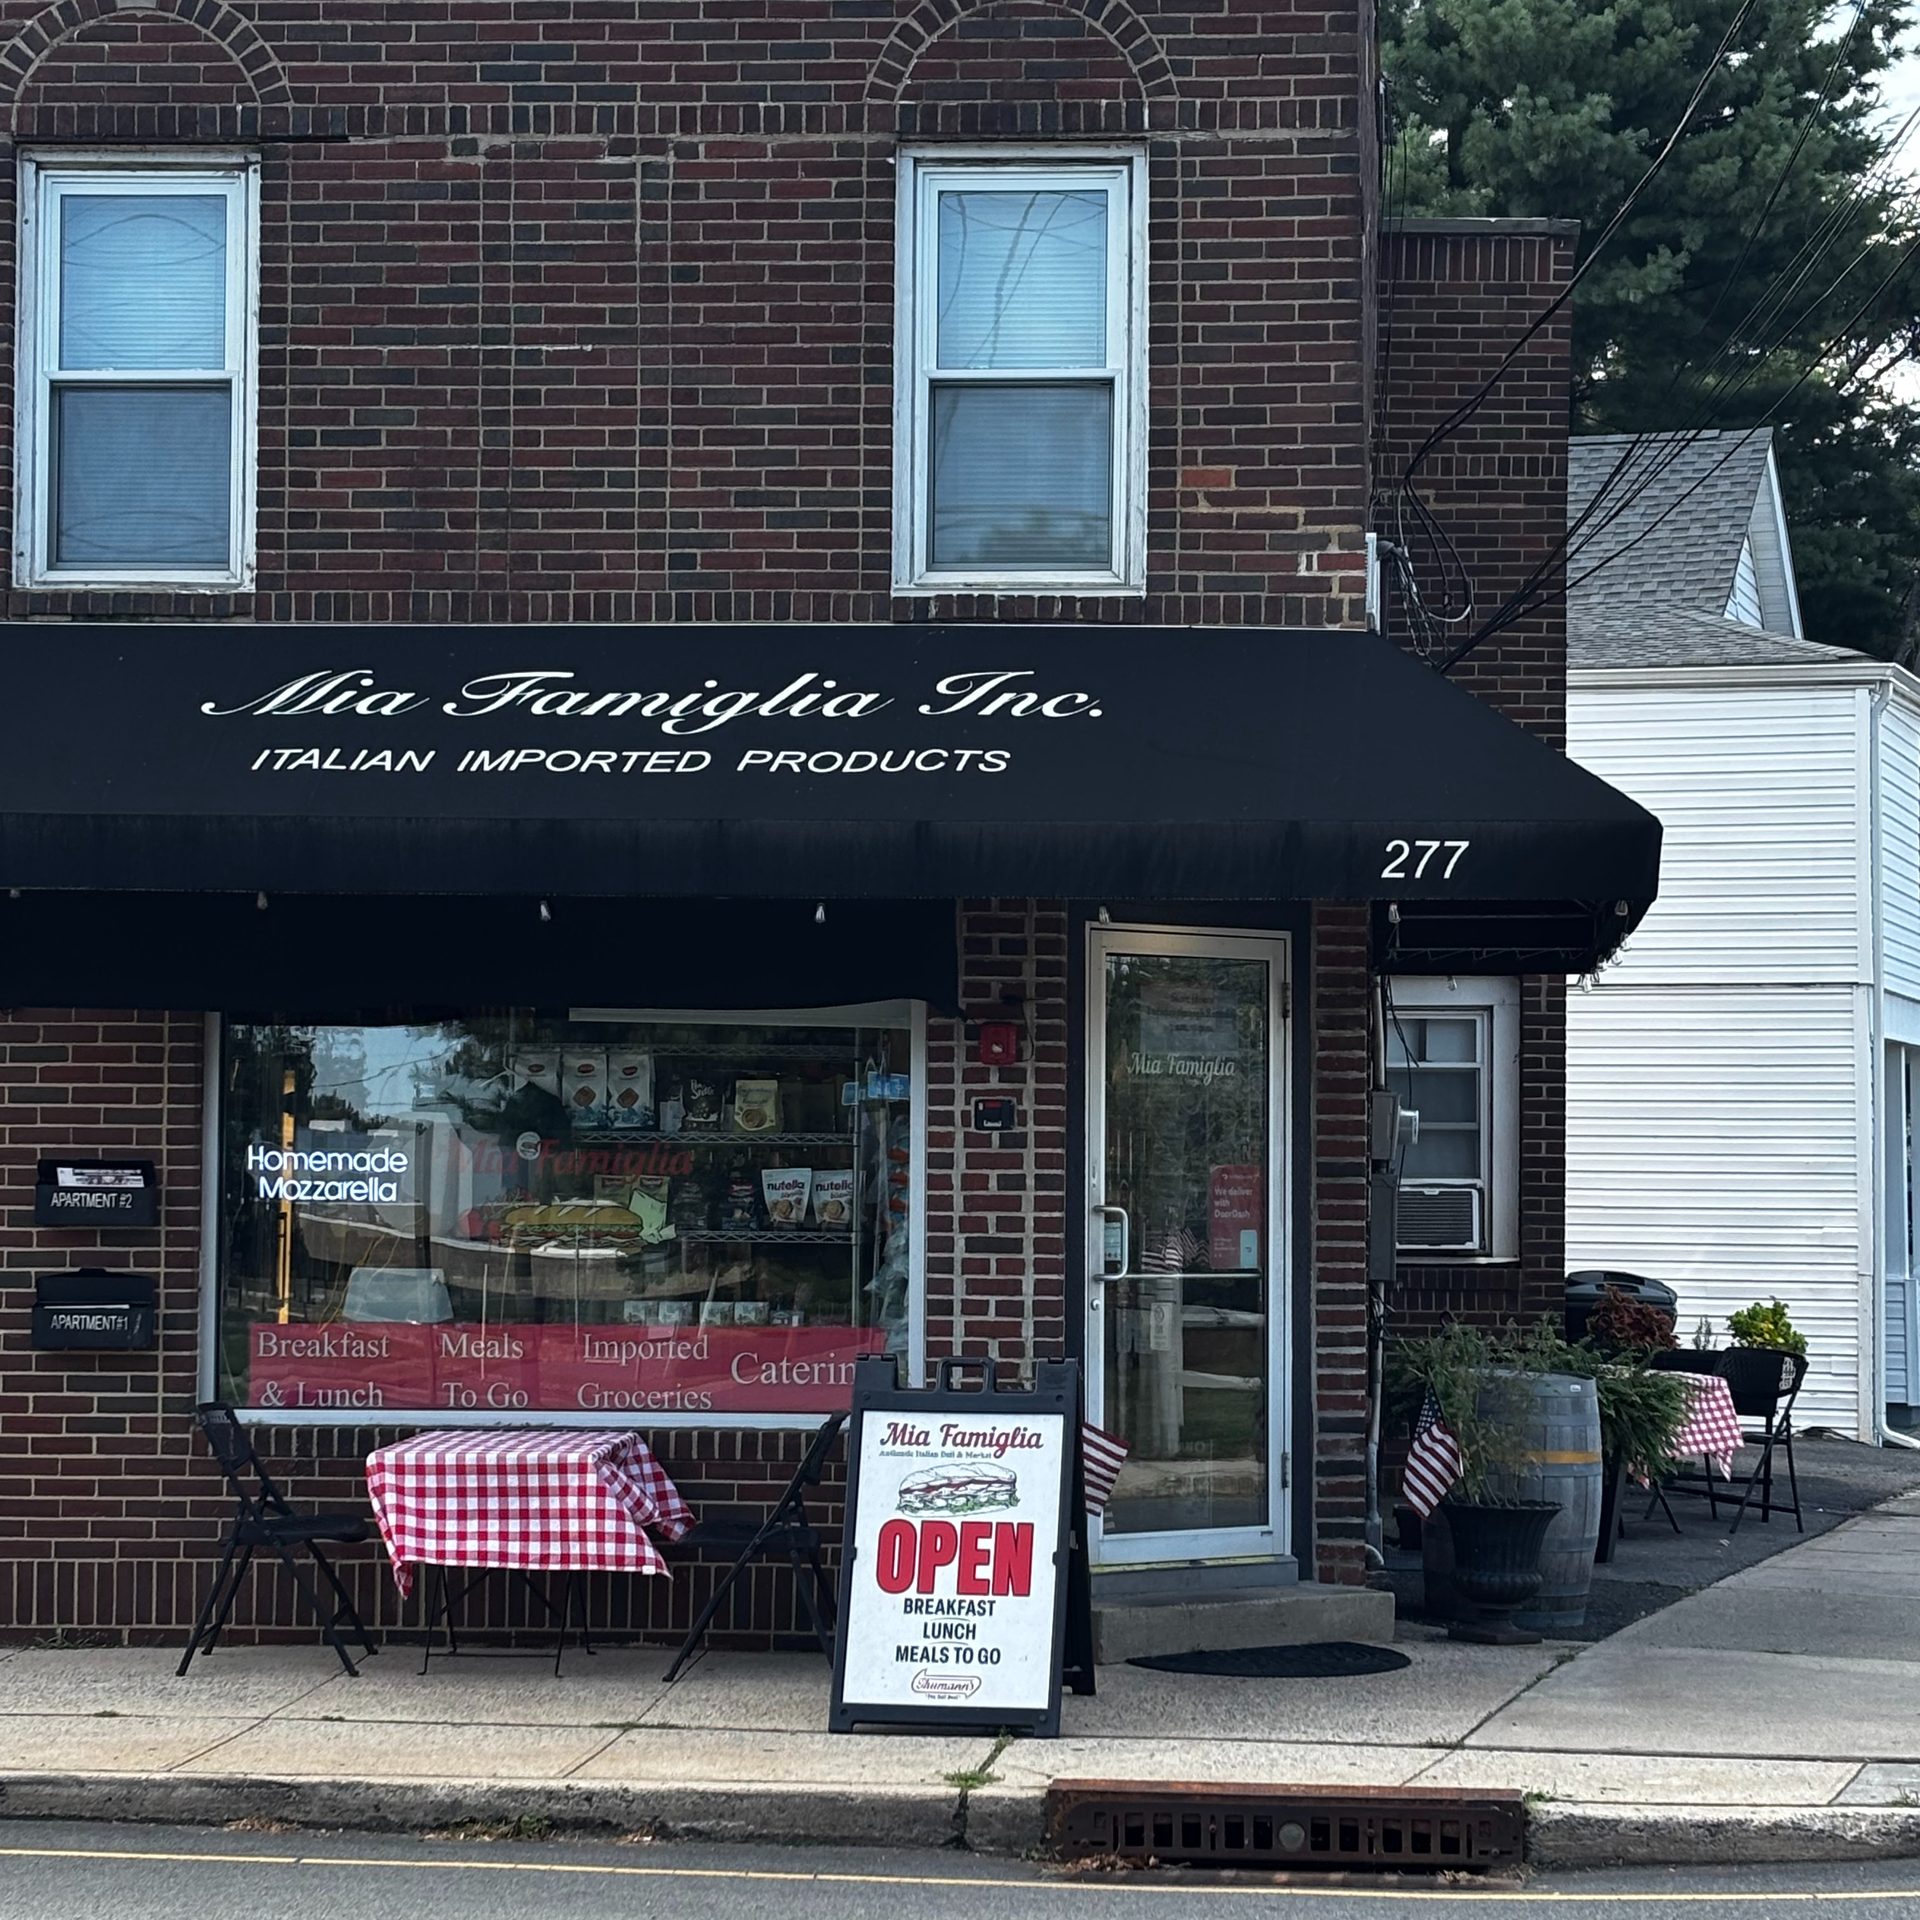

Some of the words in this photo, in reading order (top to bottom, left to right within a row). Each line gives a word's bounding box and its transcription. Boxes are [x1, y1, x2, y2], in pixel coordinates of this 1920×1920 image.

[200, 669, 430, 716] Mia
[442, 670, 895, 735] Famiglia
[918, 670, 1103, 718] Inc.
[251, 748, 436, 772] ITALIAN
[457, 748, 712, 773] IMPORTED
[737, 748, 1011, 773] PRODUCTS
[1381, 839, 1470, 879] 277
[1127, 1052, 1163, 1075] Mia
[1167, 1053, 1236, 1086] Famiglia
[247, 1144, 408, 1173] Homemade
[536, 1138, 695, 1182] Famiglia
[259, 1176, 397, 1202] Mozzarella
[766, 1180, 805, 1191] nutella
[50, 1192, 118, 1208] APARTMENT
[257, 1331, 390, 1358] Breakfast
[440, 1333, 524, 1359] Meals
[583, 1334, 709, 1365] Imported
[731, 1352, 856, 1385] Caterin
[260, 1380, 286, 1407] &
[296, 1381, 384, 1407] Lunch
[442, 1382, 477, 1408] To
[487, 1382, 529, 1409] Go
[577, 1382, 712, 1410] Groceries
[879, 1422, 931, 1446] Mia
[940, 1423, 1044, 1459] Famiglia
[876, 1518, 1034, 1597] OPEN
[903, 1597, 996, 1616] BREAKFAST
[922, 1622, 976, 1640] LUNCH
[895, 1645, 950, 1663] MEALS
[953, 1646, 974, 1664] TO
[977, 1647, 1001, 1665] GO
